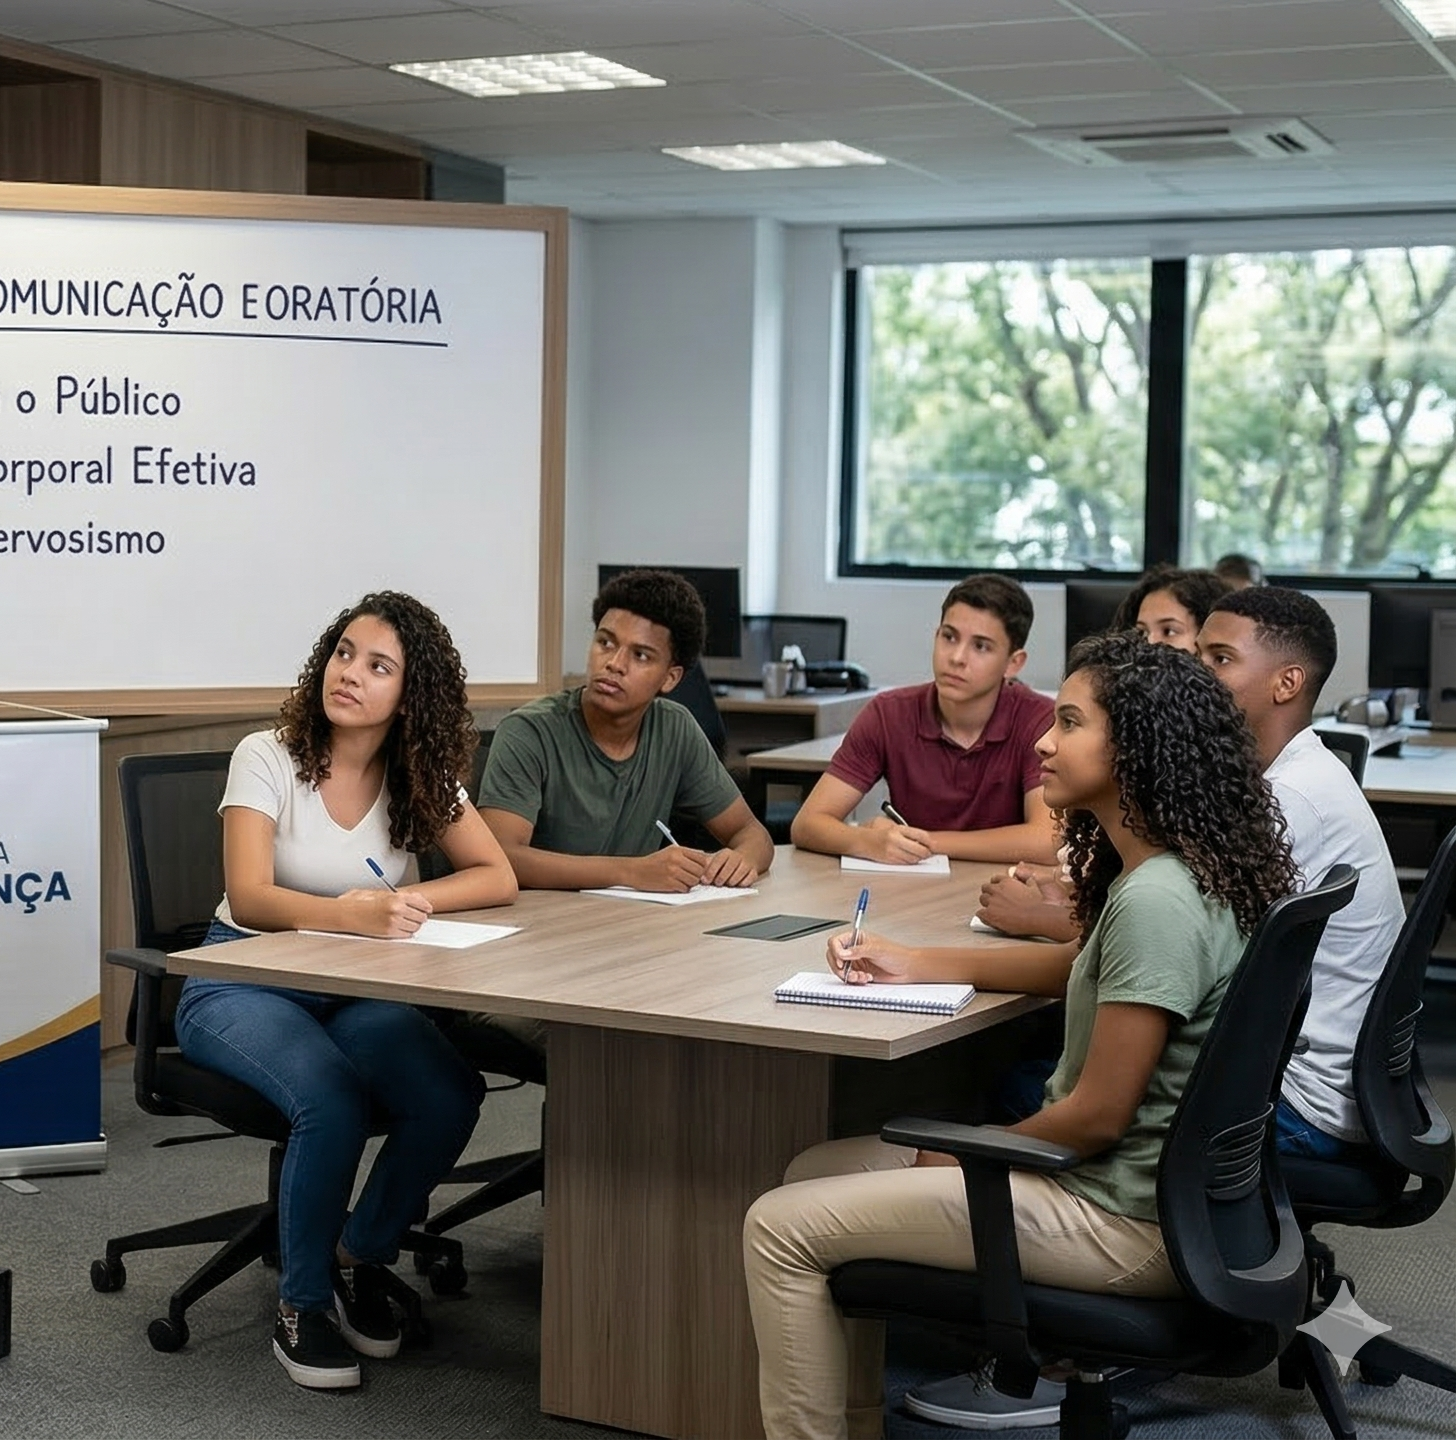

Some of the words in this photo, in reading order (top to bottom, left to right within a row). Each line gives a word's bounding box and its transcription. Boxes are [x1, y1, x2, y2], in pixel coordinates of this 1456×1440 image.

[17, 390, 36, 414] o
[57, 376, 181, 417] Público
[133, 446, 256, 486] Efetiva
